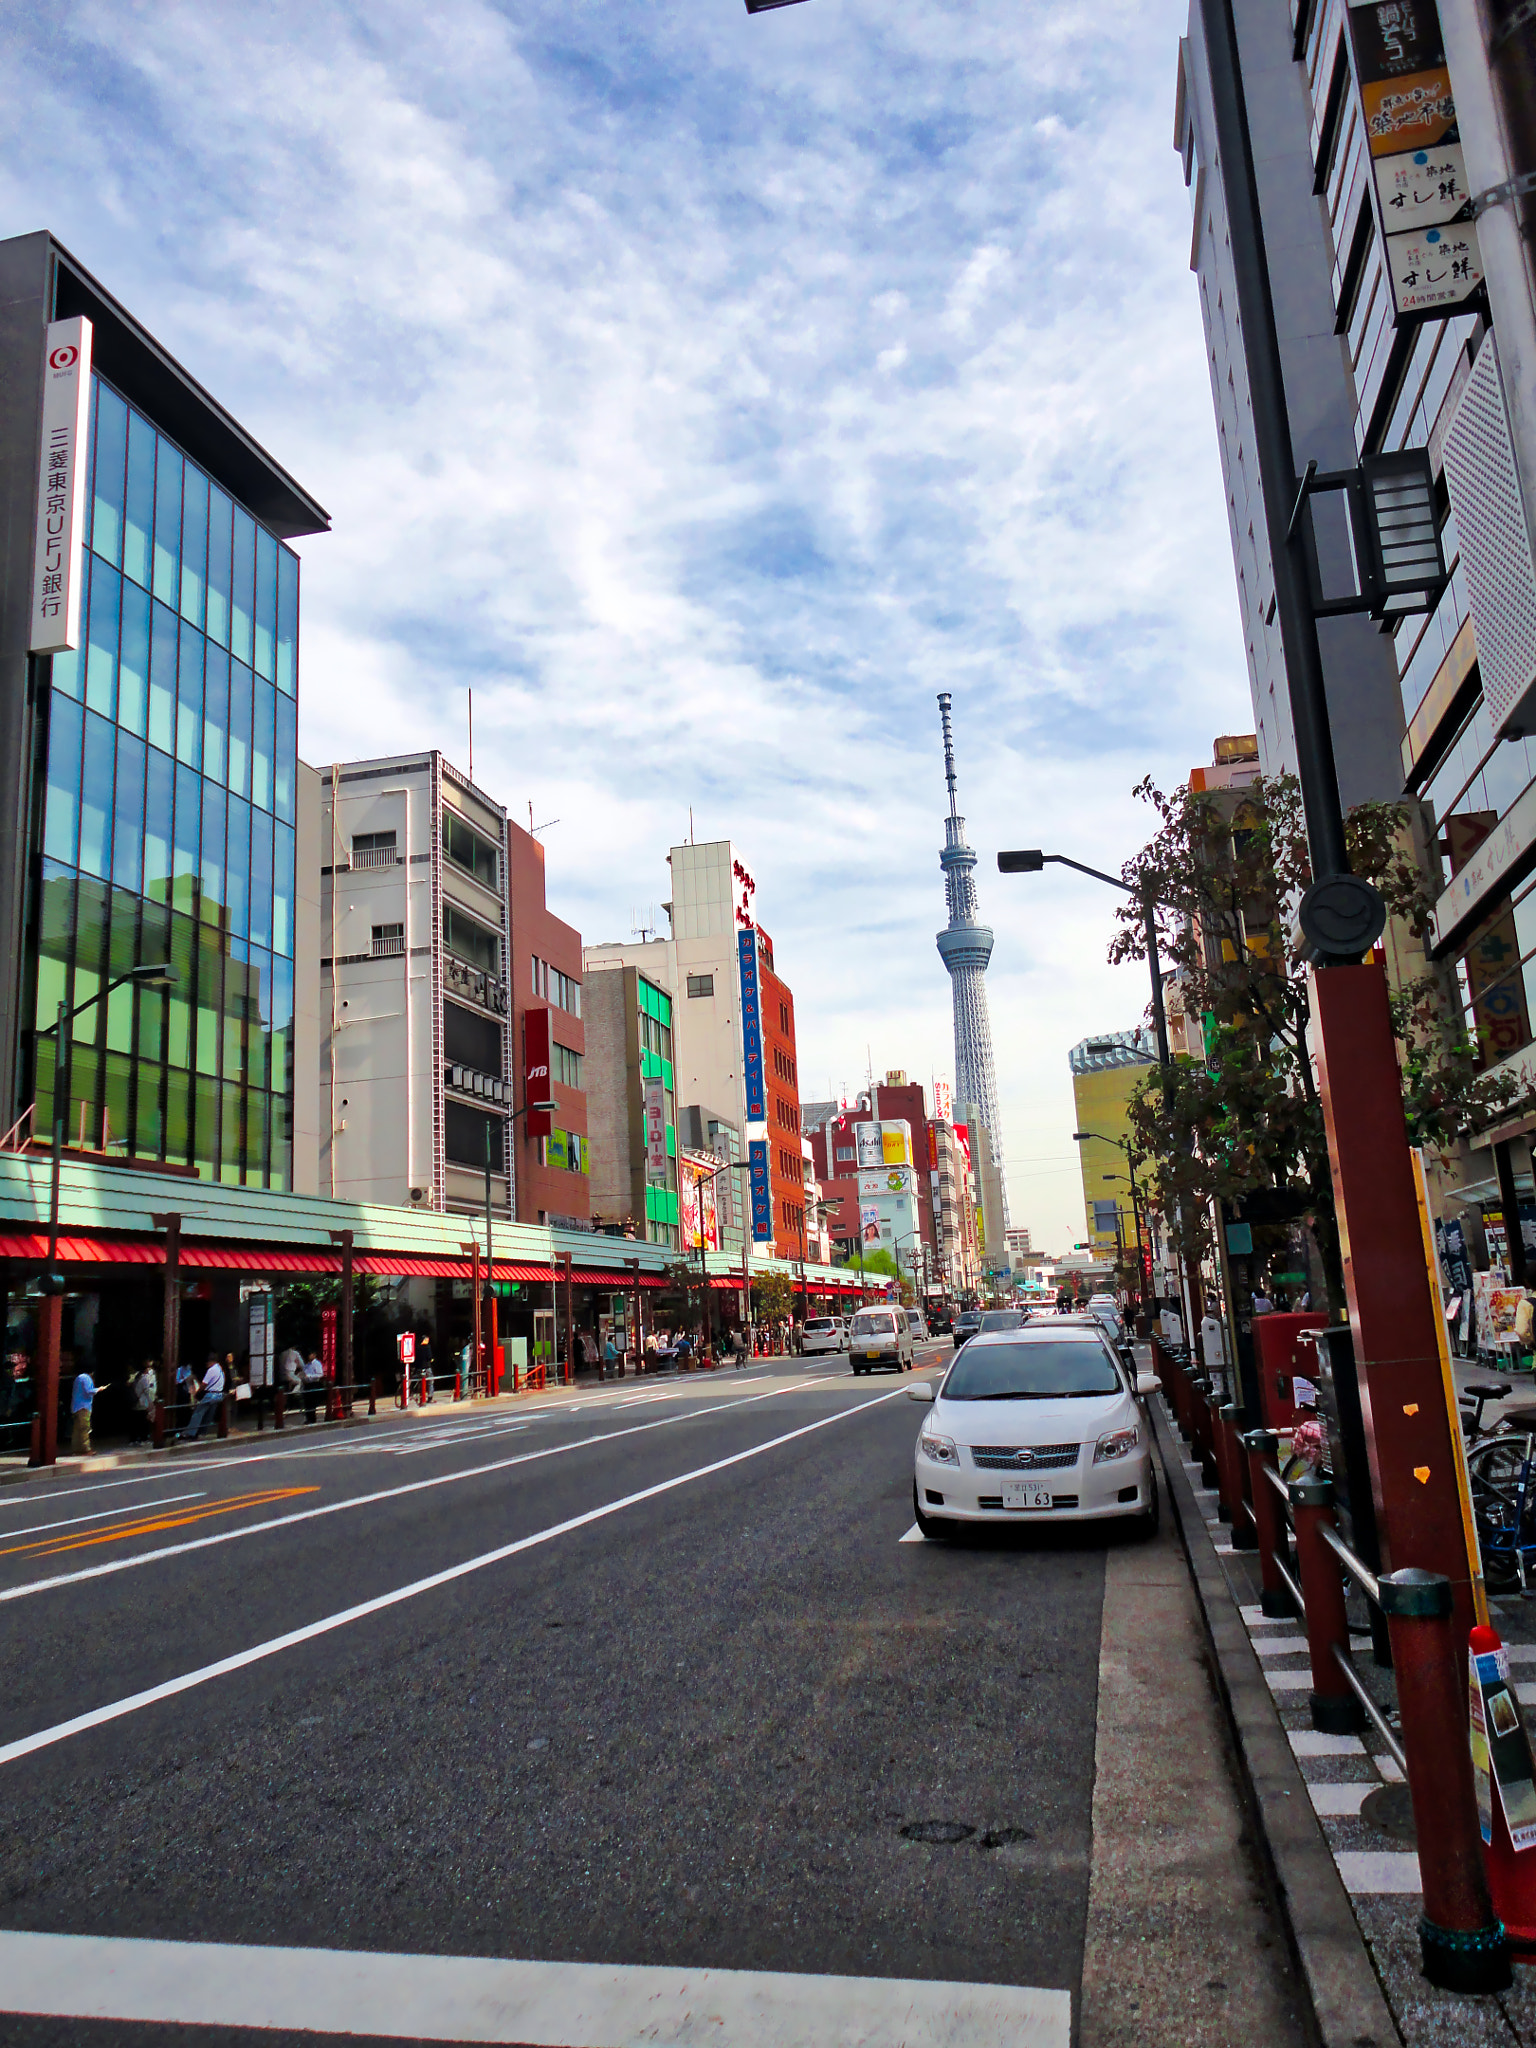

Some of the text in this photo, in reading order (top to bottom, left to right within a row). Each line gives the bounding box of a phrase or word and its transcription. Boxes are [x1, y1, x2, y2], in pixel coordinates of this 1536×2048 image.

[1389, 178, 1460, 209] すし鮮
[1402, 257, 1474, 288] すし鮮
[41, 427, 69, 618] 三菱東京UFJ銀行
[527, 1065, 548, 1080] JTB
[934, 1082, 943, 1118] SHIDAX
[942, 1082, 950, 1119] カラオケ
[859, 1137, 881, 1148] Asahi
[753, 1149, 767, 1233] カラオケ館
